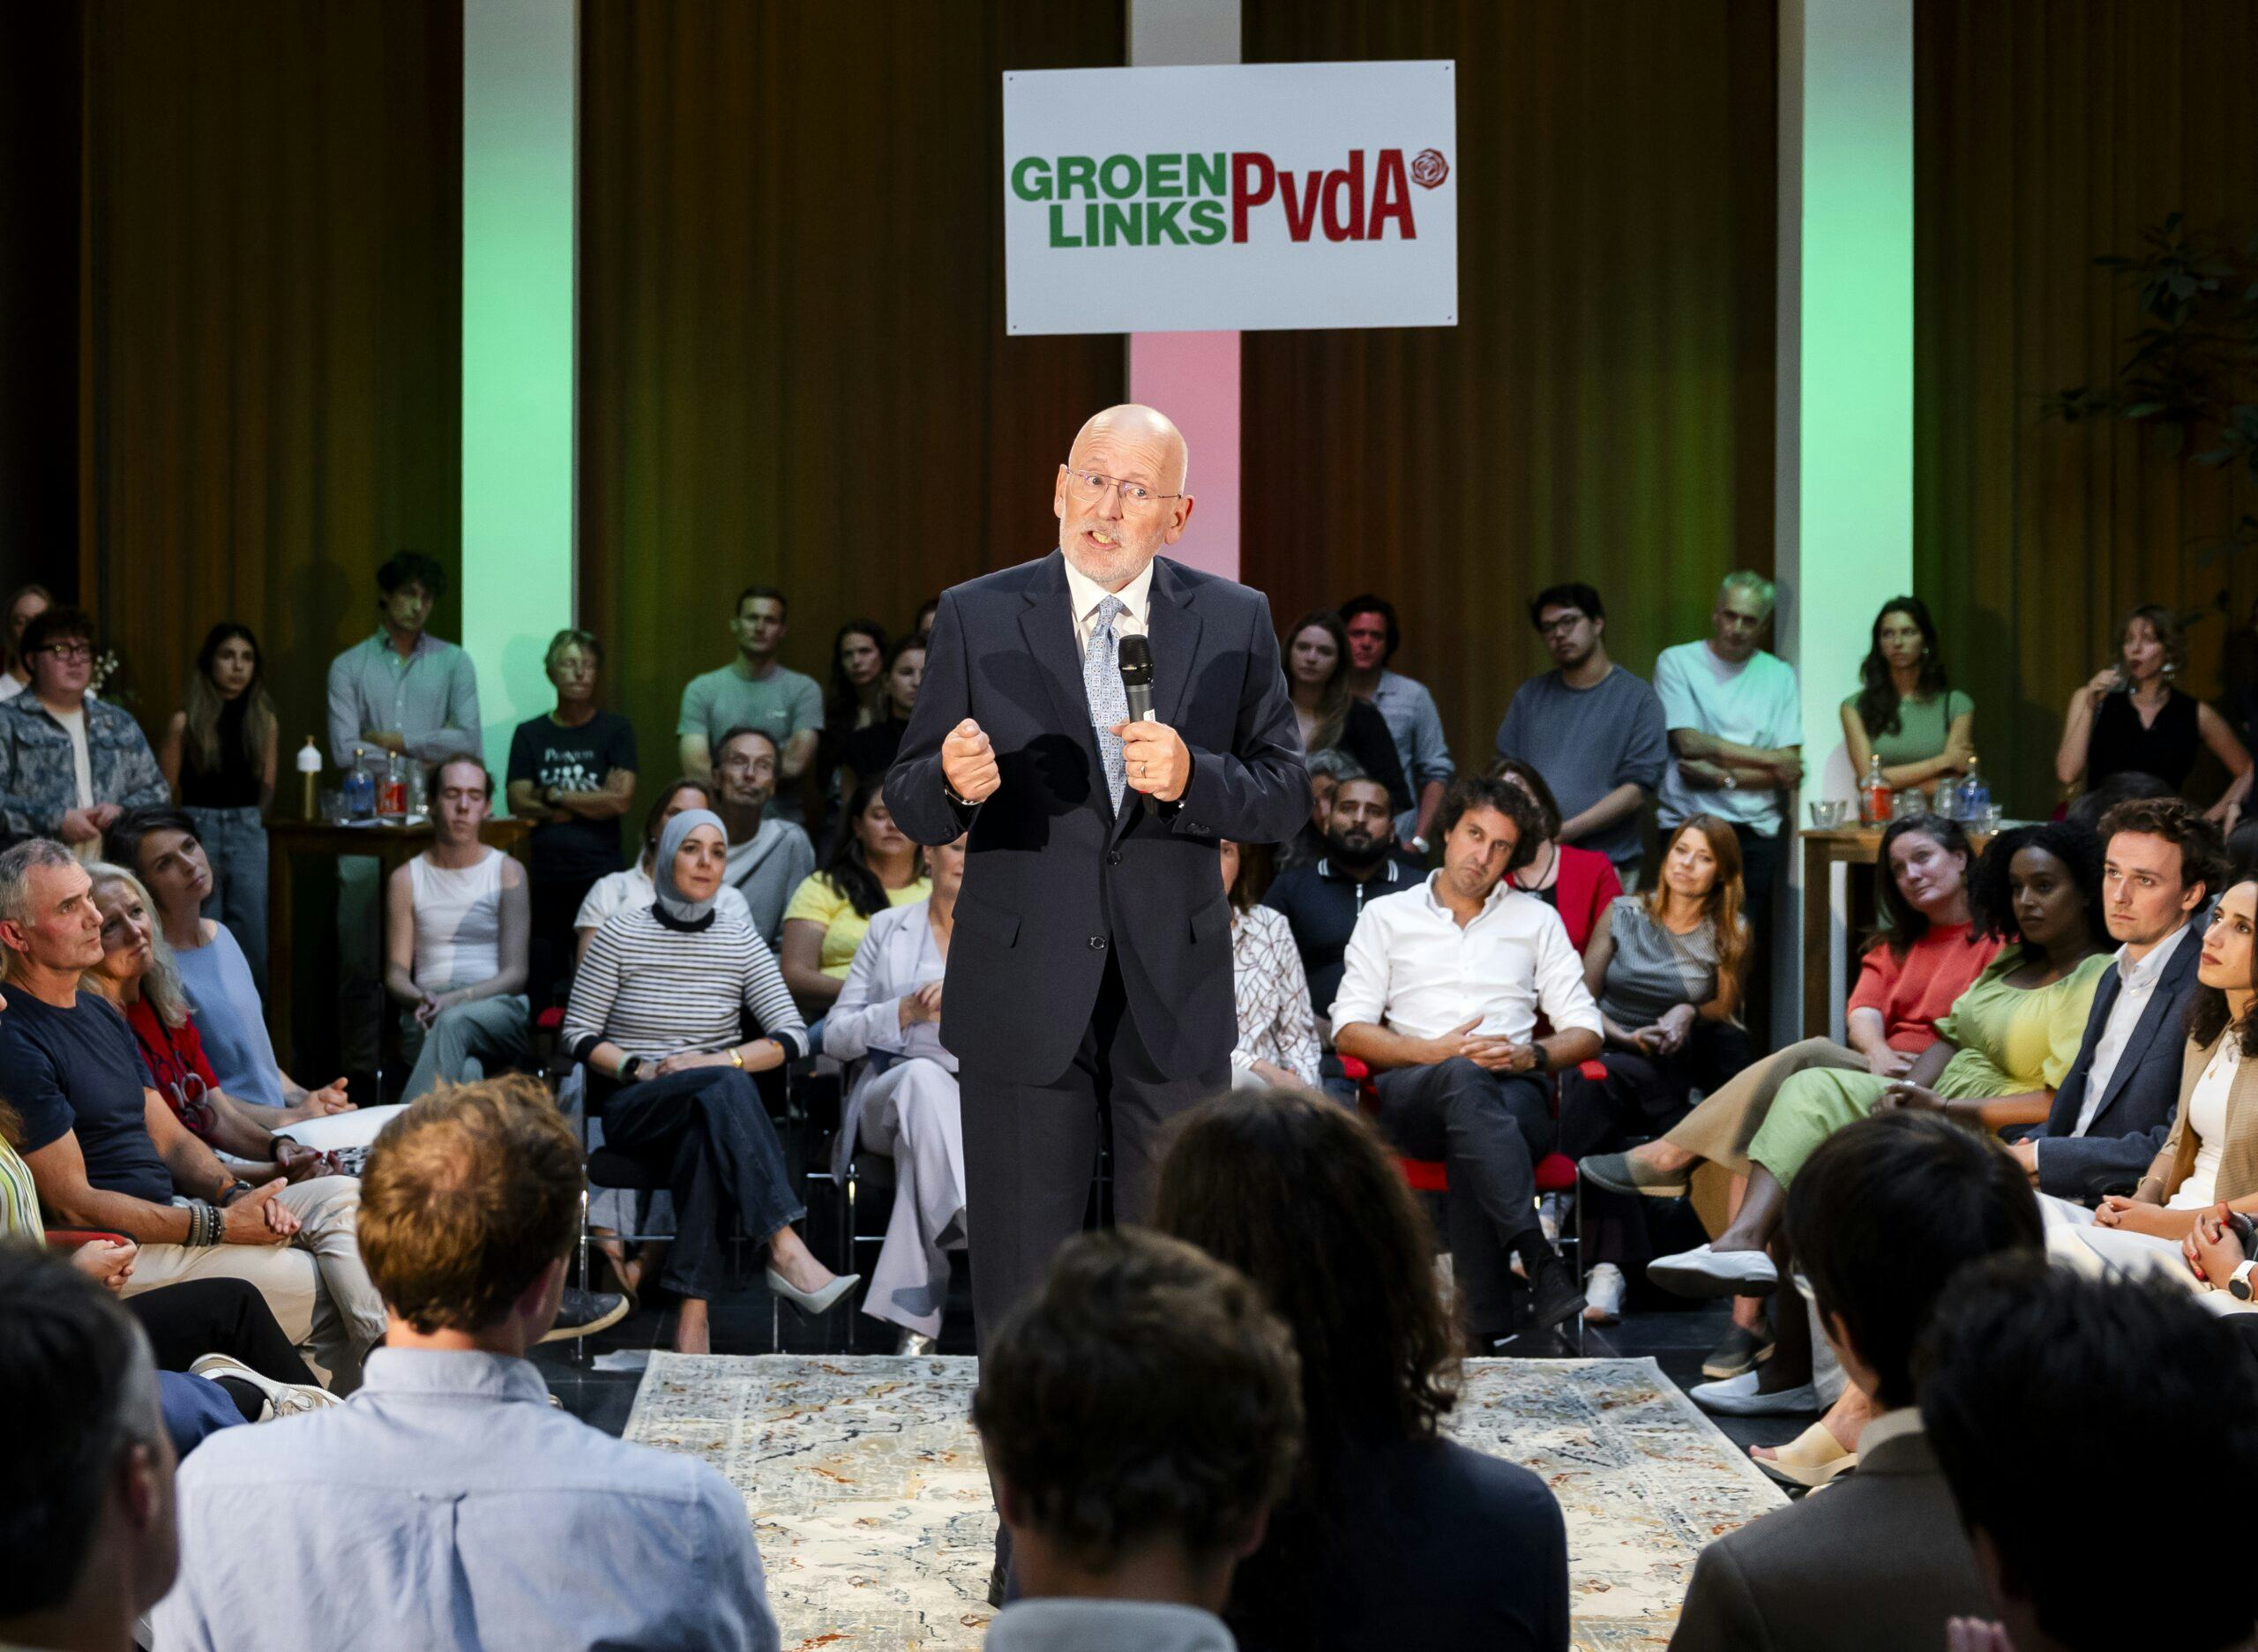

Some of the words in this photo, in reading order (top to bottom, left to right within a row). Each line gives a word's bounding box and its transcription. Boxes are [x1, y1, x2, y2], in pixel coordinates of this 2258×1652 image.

[1012, 152, 1227, 201] GROEN
[1232, 149, 1417, 243] PvdA
[1050, 200, 1227, 248] LINKS
